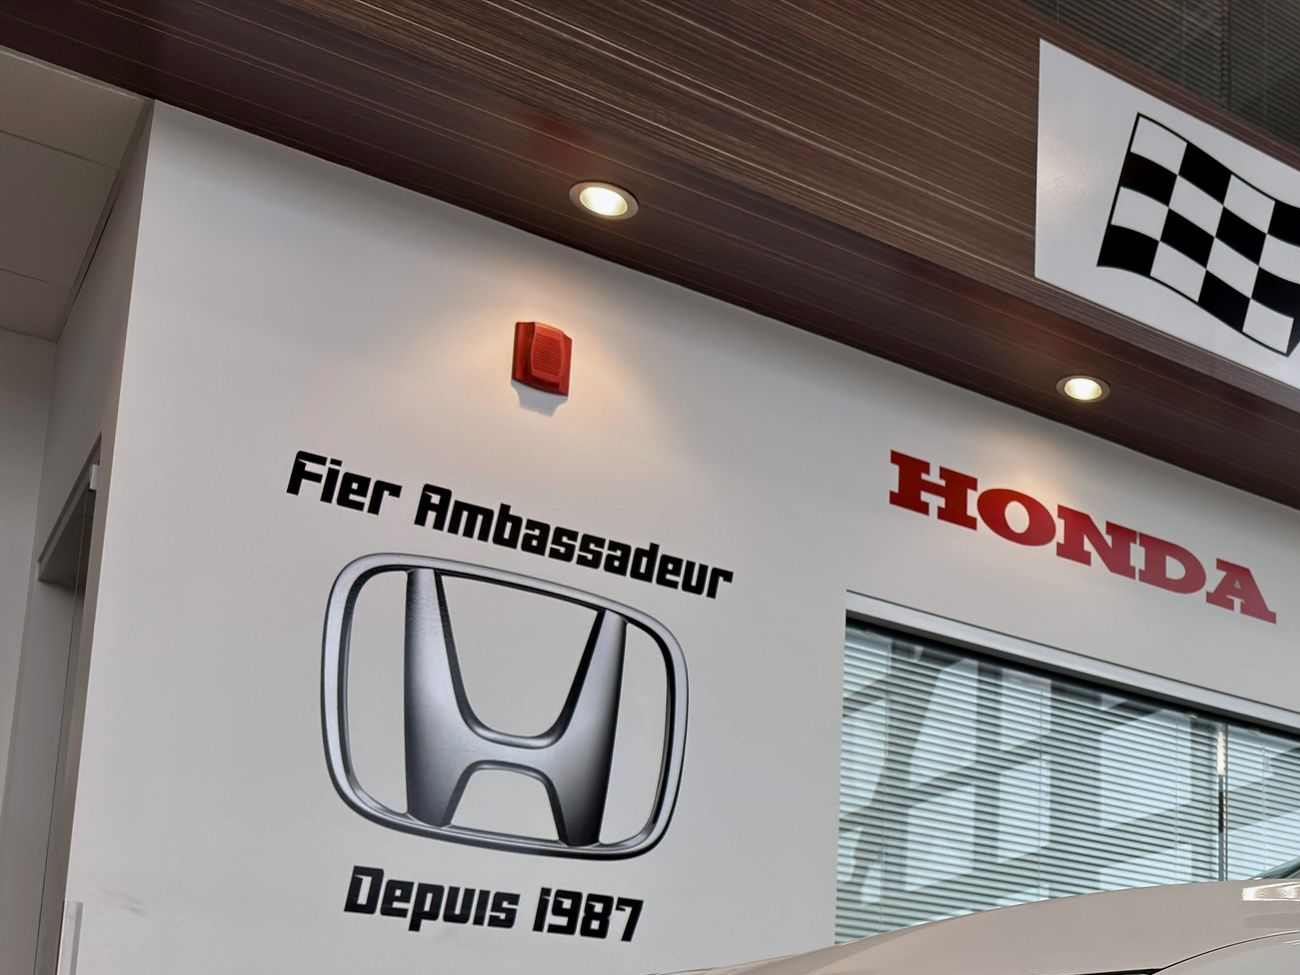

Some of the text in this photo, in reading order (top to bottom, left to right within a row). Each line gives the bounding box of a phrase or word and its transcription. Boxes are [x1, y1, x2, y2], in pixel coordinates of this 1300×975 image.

[286, 450, 734, 600] Fier Ambassadeur
[888, 449, 1277, 625] HONDA
[343, 865, 645, 943] Depuis 1987
